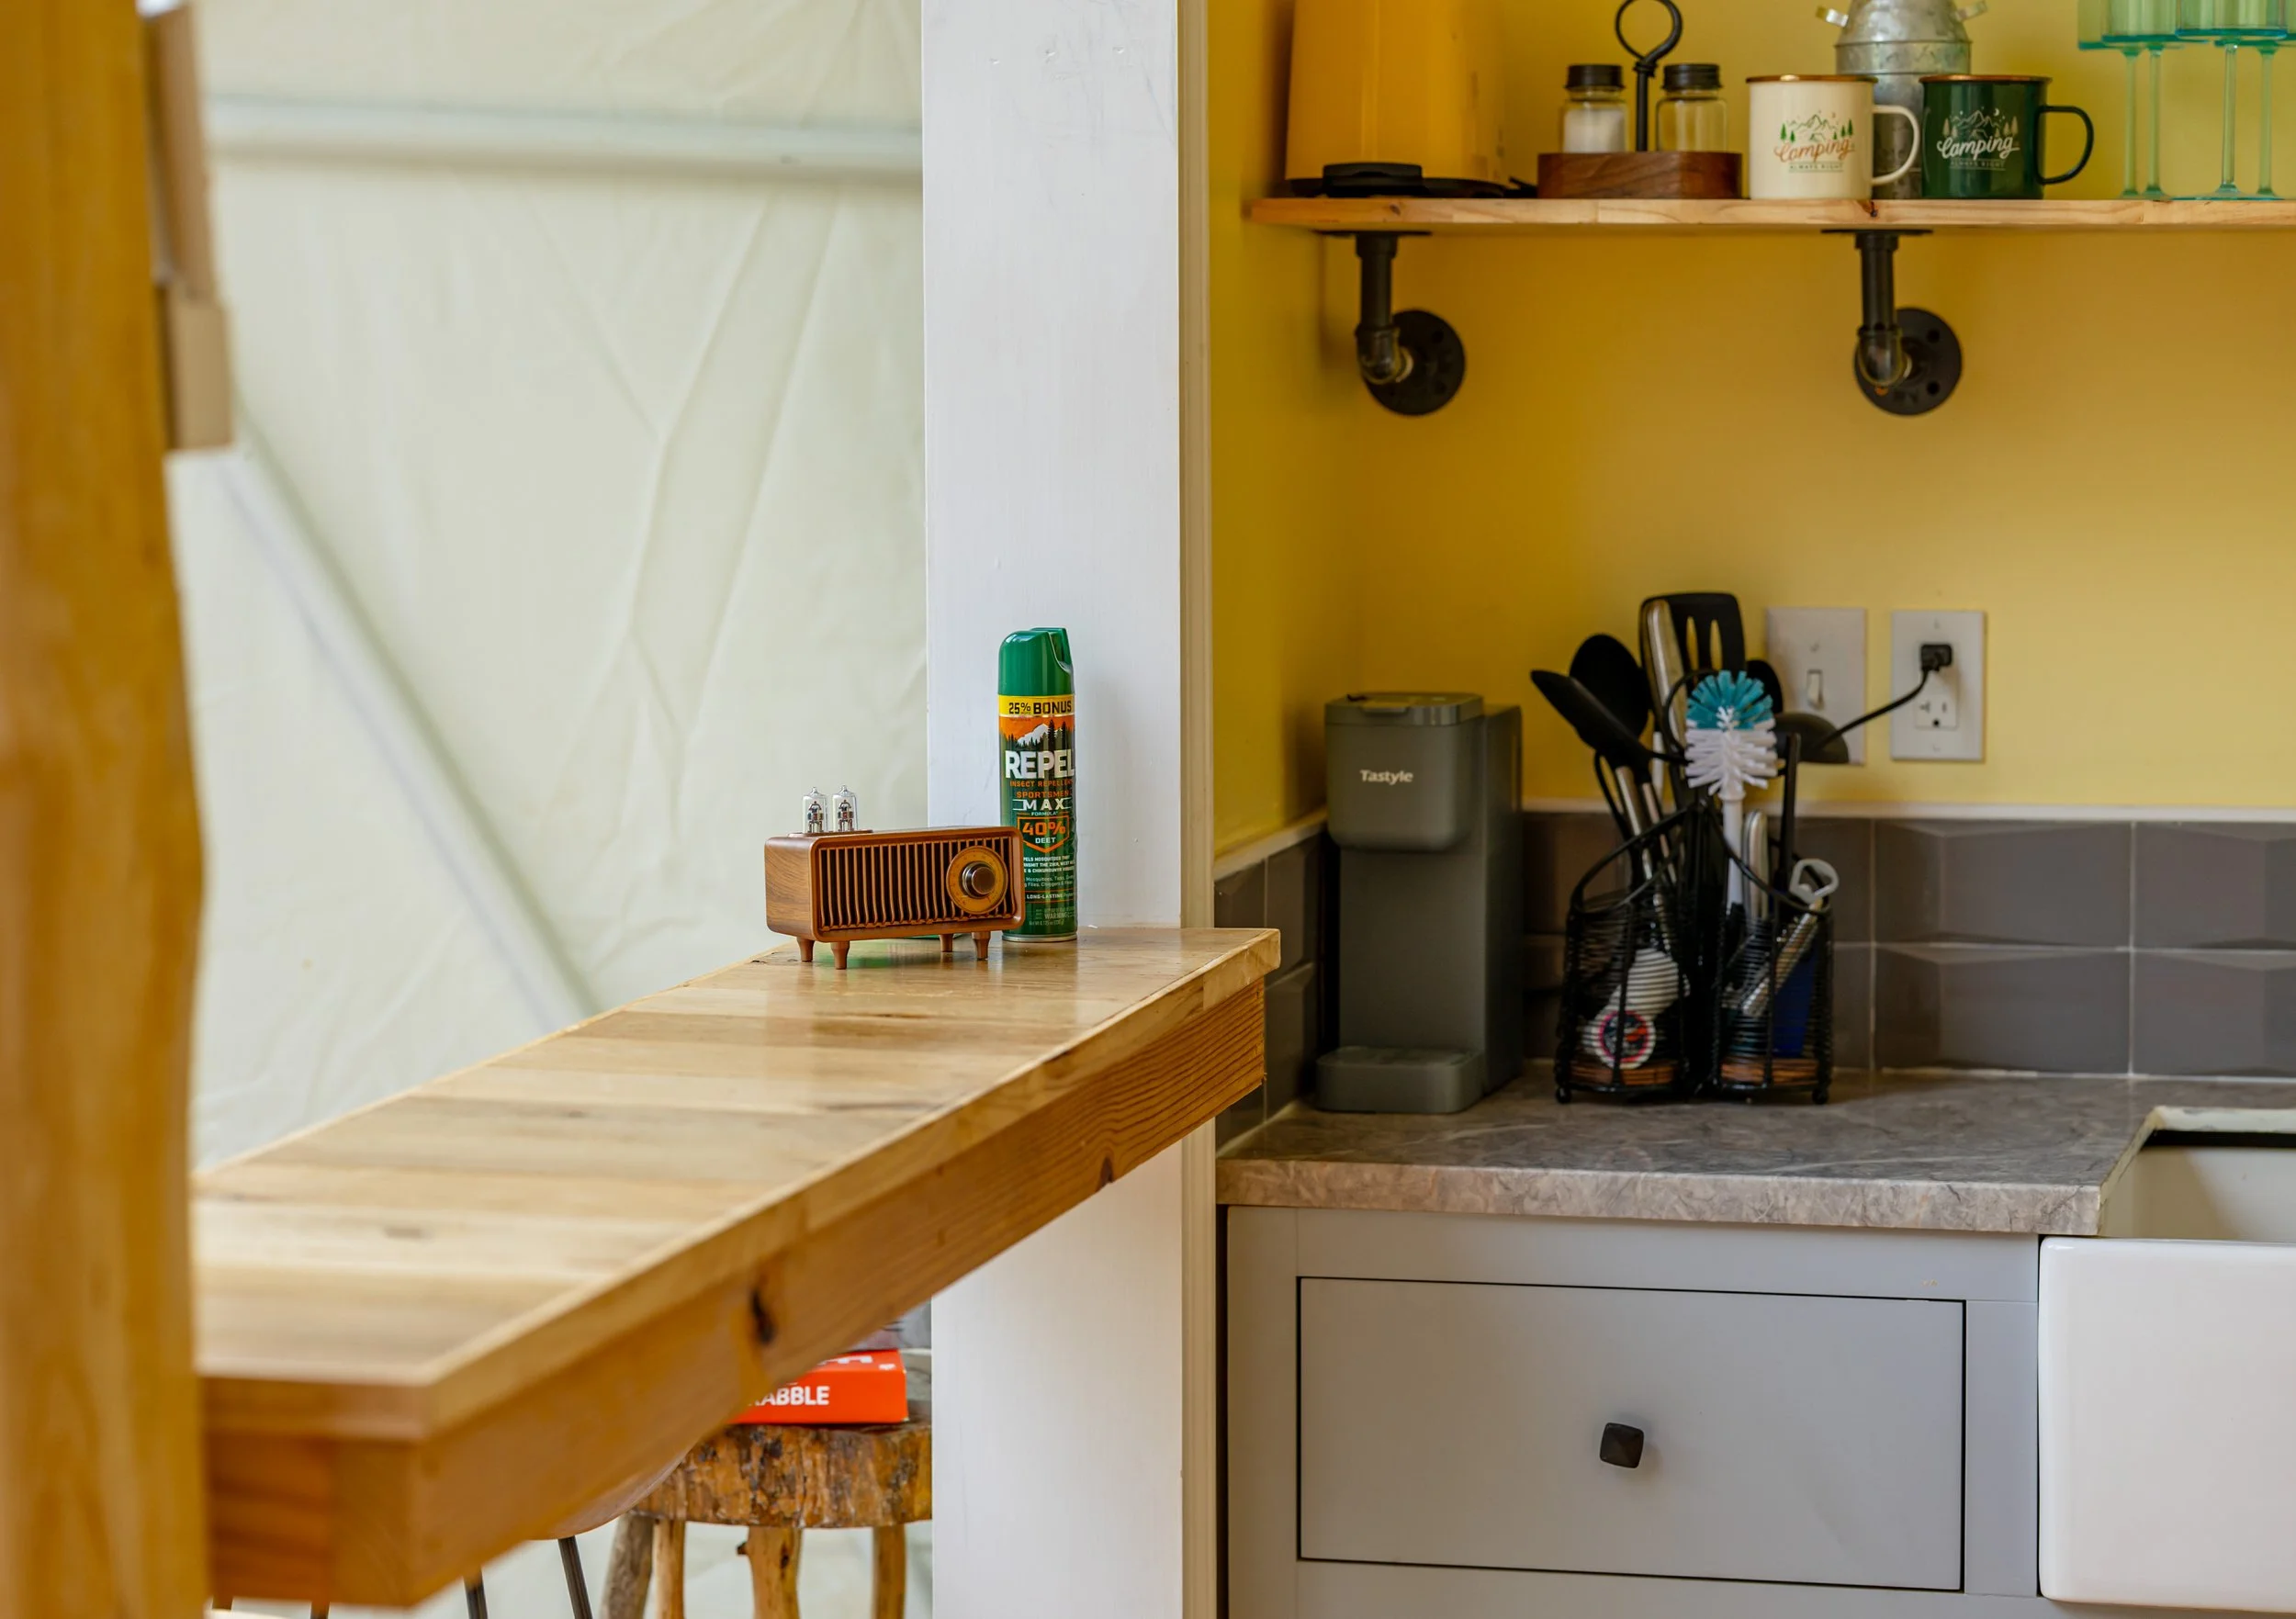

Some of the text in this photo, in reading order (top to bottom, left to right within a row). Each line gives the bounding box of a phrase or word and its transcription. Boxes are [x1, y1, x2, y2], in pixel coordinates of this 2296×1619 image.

[1773, 138, 1855, 163] Camping
[1936, 135, 2020, 161] Camping
[1008, 701, 1072, 714] 25% BONUS
[1005, 749, 1075, 780] REPEL
[1359, 770, 1413, 785] Tastyle
[1022, 798, 1064, 811] MAX
[1022, 820, 1066, 836] 40%
[755, 1386, 830, 1406] ABBLE
